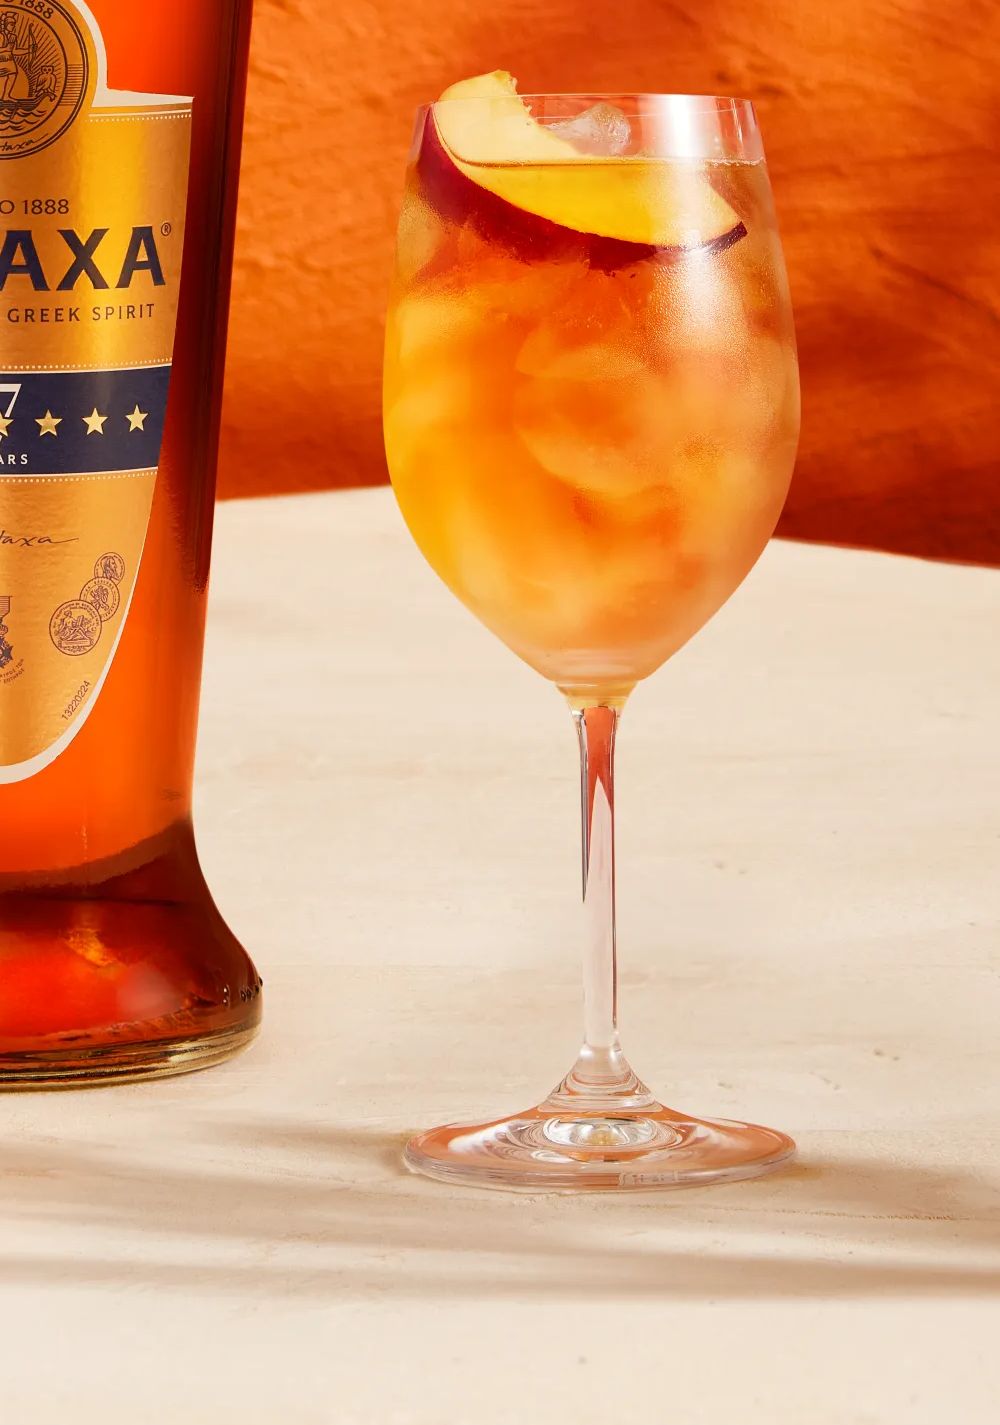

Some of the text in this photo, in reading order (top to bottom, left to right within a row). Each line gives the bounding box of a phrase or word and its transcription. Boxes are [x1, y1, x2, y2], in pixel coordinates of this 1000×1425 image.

[23, 198, 70, 215] 1888
[7, 306, 81, 323] GREEK
[91, 302, 155, 322] SPIRIT
[61, 680, 91, 721] 13220224
